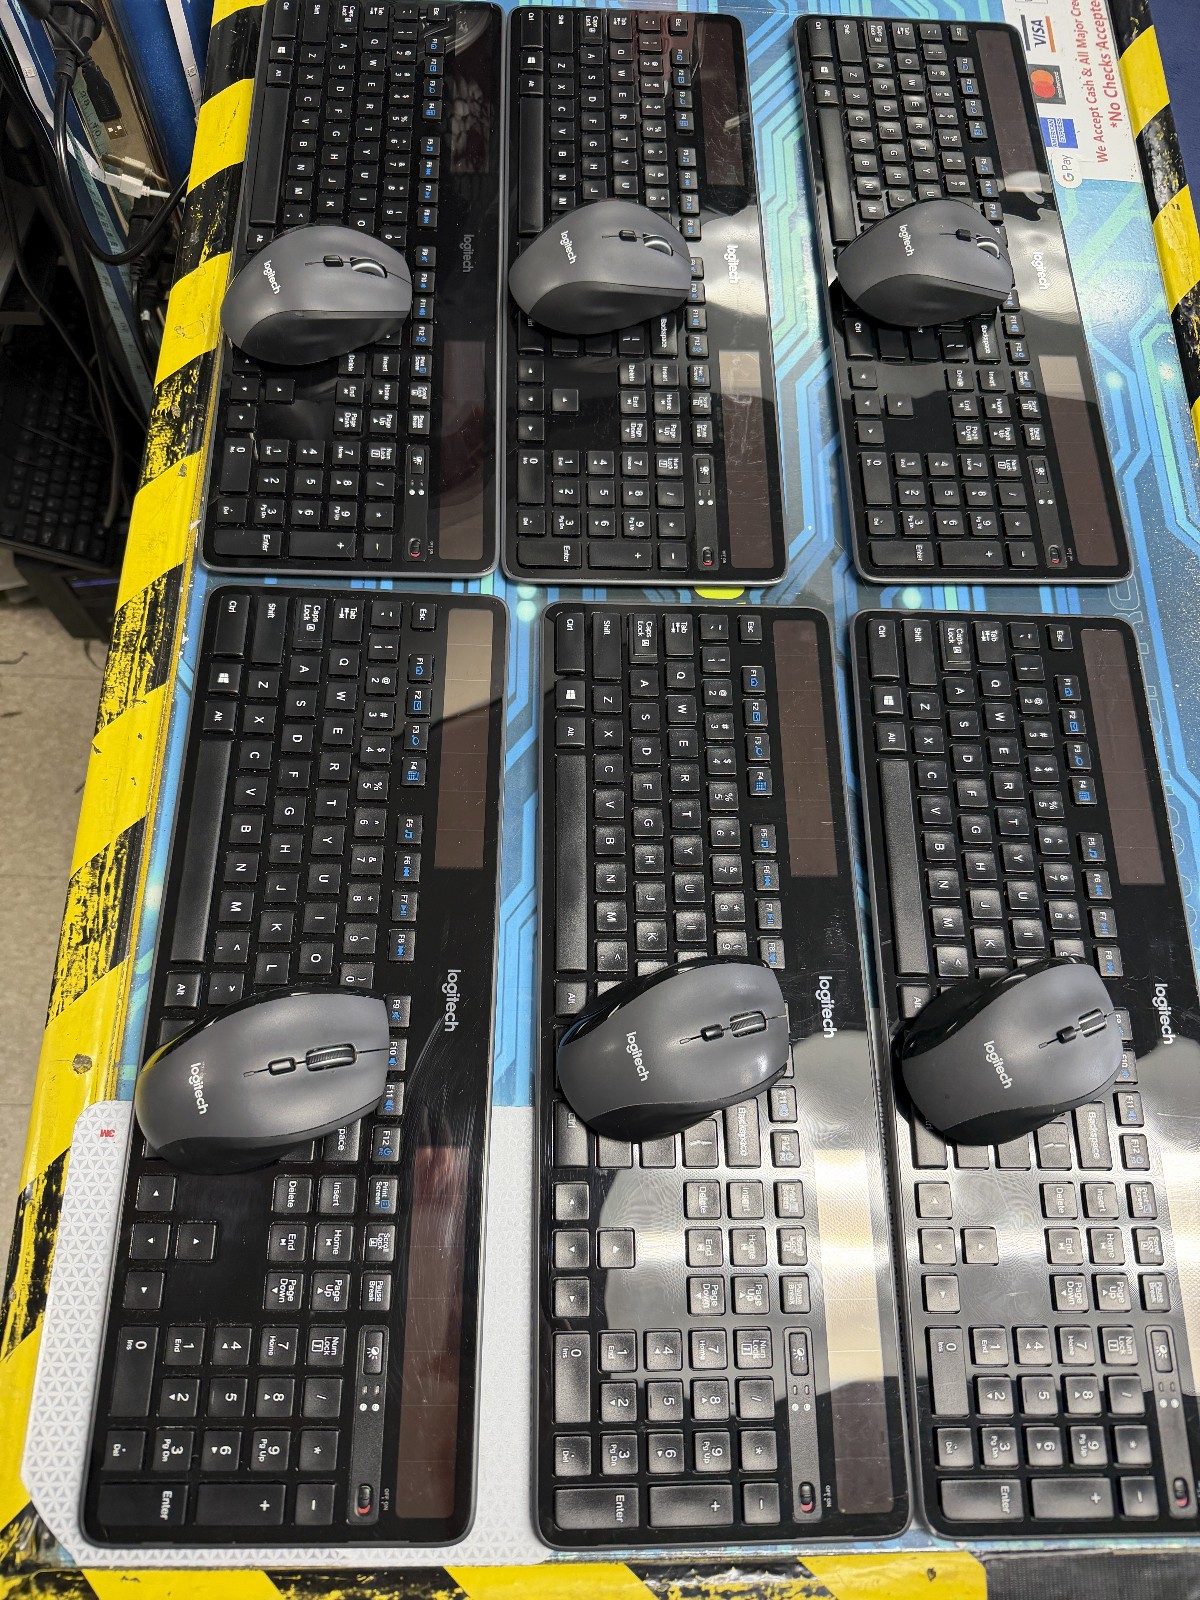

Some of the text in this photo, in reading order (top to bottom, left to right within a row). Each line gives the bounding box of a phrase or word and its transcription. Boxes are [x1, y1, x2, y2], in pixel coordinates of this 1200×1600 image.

[1031, 20, 1047, 48] VISA
[1075, 21, 1088, 49] Major
[1079, 52, 1091, 65] All
[1081, 67, 1092, 77] &
[1098, 54, 1119, 98] Checks
[1083, 82, 1097, 104] Cash
[1056, 118, 1067, 144] EXPRESS
[1088, 106, 1103, 142] Accept
[1047, 120, 1058, 148] AMERICAN
[1062, 154, 1074, 171] Pay
[1094, 145, 1109, 163] We
[560, 230, 577, 264] logitech
[899, 223, 915, 257] logitech
[459, 234, 475, 273] logitech
[723, 244, 739, 284] logitech
[1031, 252, 1049, 290] logitech
[263, 260, 281, 295] logitech
[262, 534, 270, 552] Enter
[563, 545, 571, 562] Enter
[228, 600, 237, 612] Ctrl
[267, 603, 276, 618] Shift
[303, 604, 311, 620] Lock
[312, 605, 321, 622] Caps
[645, 621, 653, 638] Caps
[299, 665, 309, 673] A
[336, 691, 346, 701] W
[415, 691, 421, 699] F2
[753, 702, 759, 710] F2
[214, 711, 222, 721] Alt
[411, 762, 417, 770] F4
[284, 807, 294, 815] G
[406, 819, 413, 827] F5
[761, 829, 768, 838] F5
[404, 856, 411, 865] F6
[764, 866, 770, 874] F6
[230, 902, 242, 911] M
[401, 895, 408, 903] F7
[766, 904, 773, 912] F7
[1100, 912, 1107, 921] F7
[271, 923, 282, 931] K
[398, 934, 405, 943] F8
[769, 943, 776, 952] F8
[1105, 951, 1113, 960] F8
[176, 984, 186, 995] Alt
[393, 1000, 400, 1009] F9
[440, 969, 462, 1032] logitech
[568, 993, 576, 1004] Alt
[815, 975, 837, 1038] logitech
[1151, 983, 1177, 1045] logitech
[625, 1031, 648, 1082] logitech
[983, 1040, 1013, 1089] logitech
[190, 1062, 209, 1115] logitech
[386, 1085, 395, 1097] F11
[382, 1131, 390, 1145] F12
[287, 1181, 297, 1208] Delete
[333, 1182, 341, 1206] Insert
[1097, 1189, 1107, 1212] Insert
[288, 1234, 296, 1250] End
[332, 1230, 341, 1255] Home
[704, 1239, 714, 1257] End
[747, 1235, 756, 1260] Home
[1066, 1238, 1074, 1255] End
[1107, 1234, 1115, 1258] Home
[279, 1278, 288, 1303] Down
[287, 1280, 297, 1302] Page
[324, 1284, 333, 1297] Up
[333, 1280, 342, 1302] Page
[701, 1284, 710, 1309] Down
[709, 1285, 719, 1307] Page
[745, 1289, 755, 1302] Up
[753, 1284, 762, 1307] Page
[1067, 1281, 1077, 1305] Down
[1074, 1282, 1083, 1304] Page
[1108, 1286, 1118, 1302] Up
[174, 1339, 182, 1352] End
[231, 1341, 242, 1350] 4
[268, 1336, 276, 1356] Home
[278, 1342, 289, 1350] 7
[324, 1337, 332, 1355] Lock
[331, 1337, 339, 1355] Num
[751, 1340, 760, 1361] Lock
[758, 1341, 766, 1361] Num
[177, 1393, 189, 1401] 2
[225, 1393, 237, 1401] 5
[273, 1393, 284, 1401] 8
[113, 1444, 121, 1456] Del
[171, 1446, 183, 1454] 3
[220, 1446, 232, 1455] 6
[258, 1439, 267, 1462] Pg Up
[268, 1446, 280, 1455] 9
[702, 1441, 710, 1464] Pg Up
[160, 1491, 173, 1520] Enter
[1001, 1486, 1010, 1514] Enter
[616, 1495, 625, 1523] Enter
